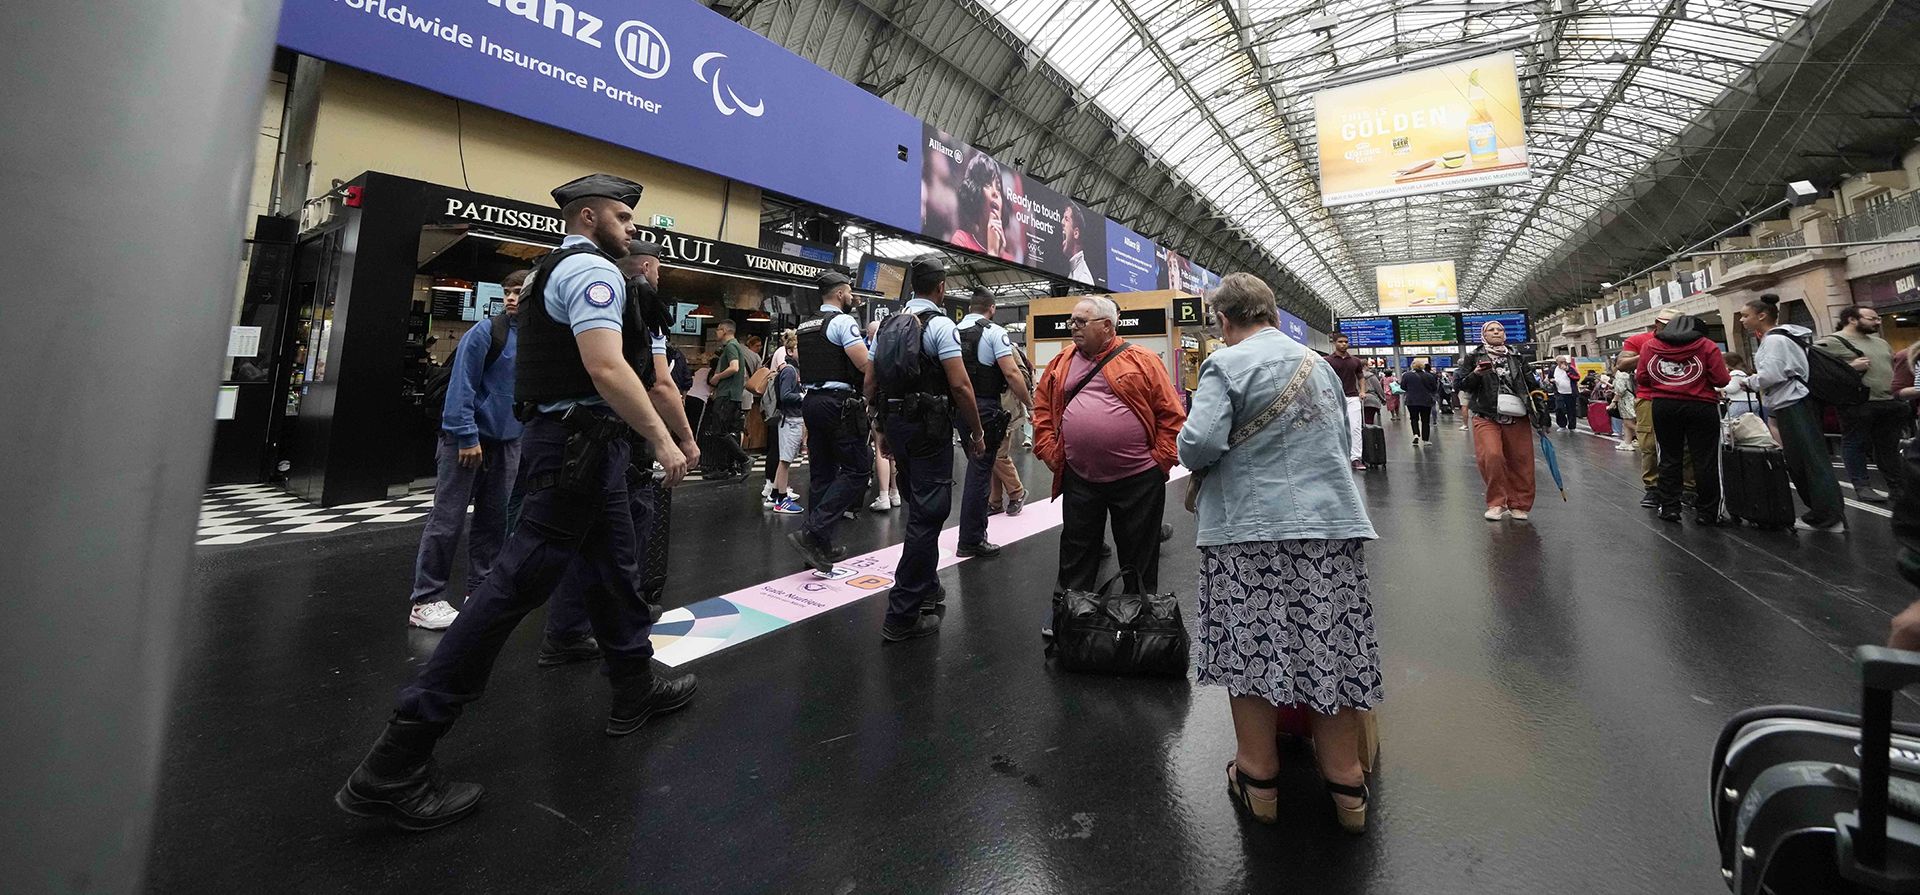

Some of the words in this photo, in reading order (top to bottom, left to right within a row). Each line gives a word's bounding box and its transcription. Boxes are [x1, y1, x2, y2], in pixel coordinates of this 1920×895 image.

[343, 0, 474, 48] orldwide
[480, 35, 588, 88] Insurance
[593, 77, 662, 115] Partner
[1341, 105, 1450, 141] GOLDEN
[928, 137, 954, 158] Allianz
[445, 198, 567, 235] PATISSERI
[1006, 187, 1032, 212] Ready
[1033, 201, 1041, 213] to
[1042, 204, 1061, 222] touch
[1016, 211, 1030, 224] our
[1895, 274, 1916, 294] RELAY
[1055, 322, 1066, 330] LE
